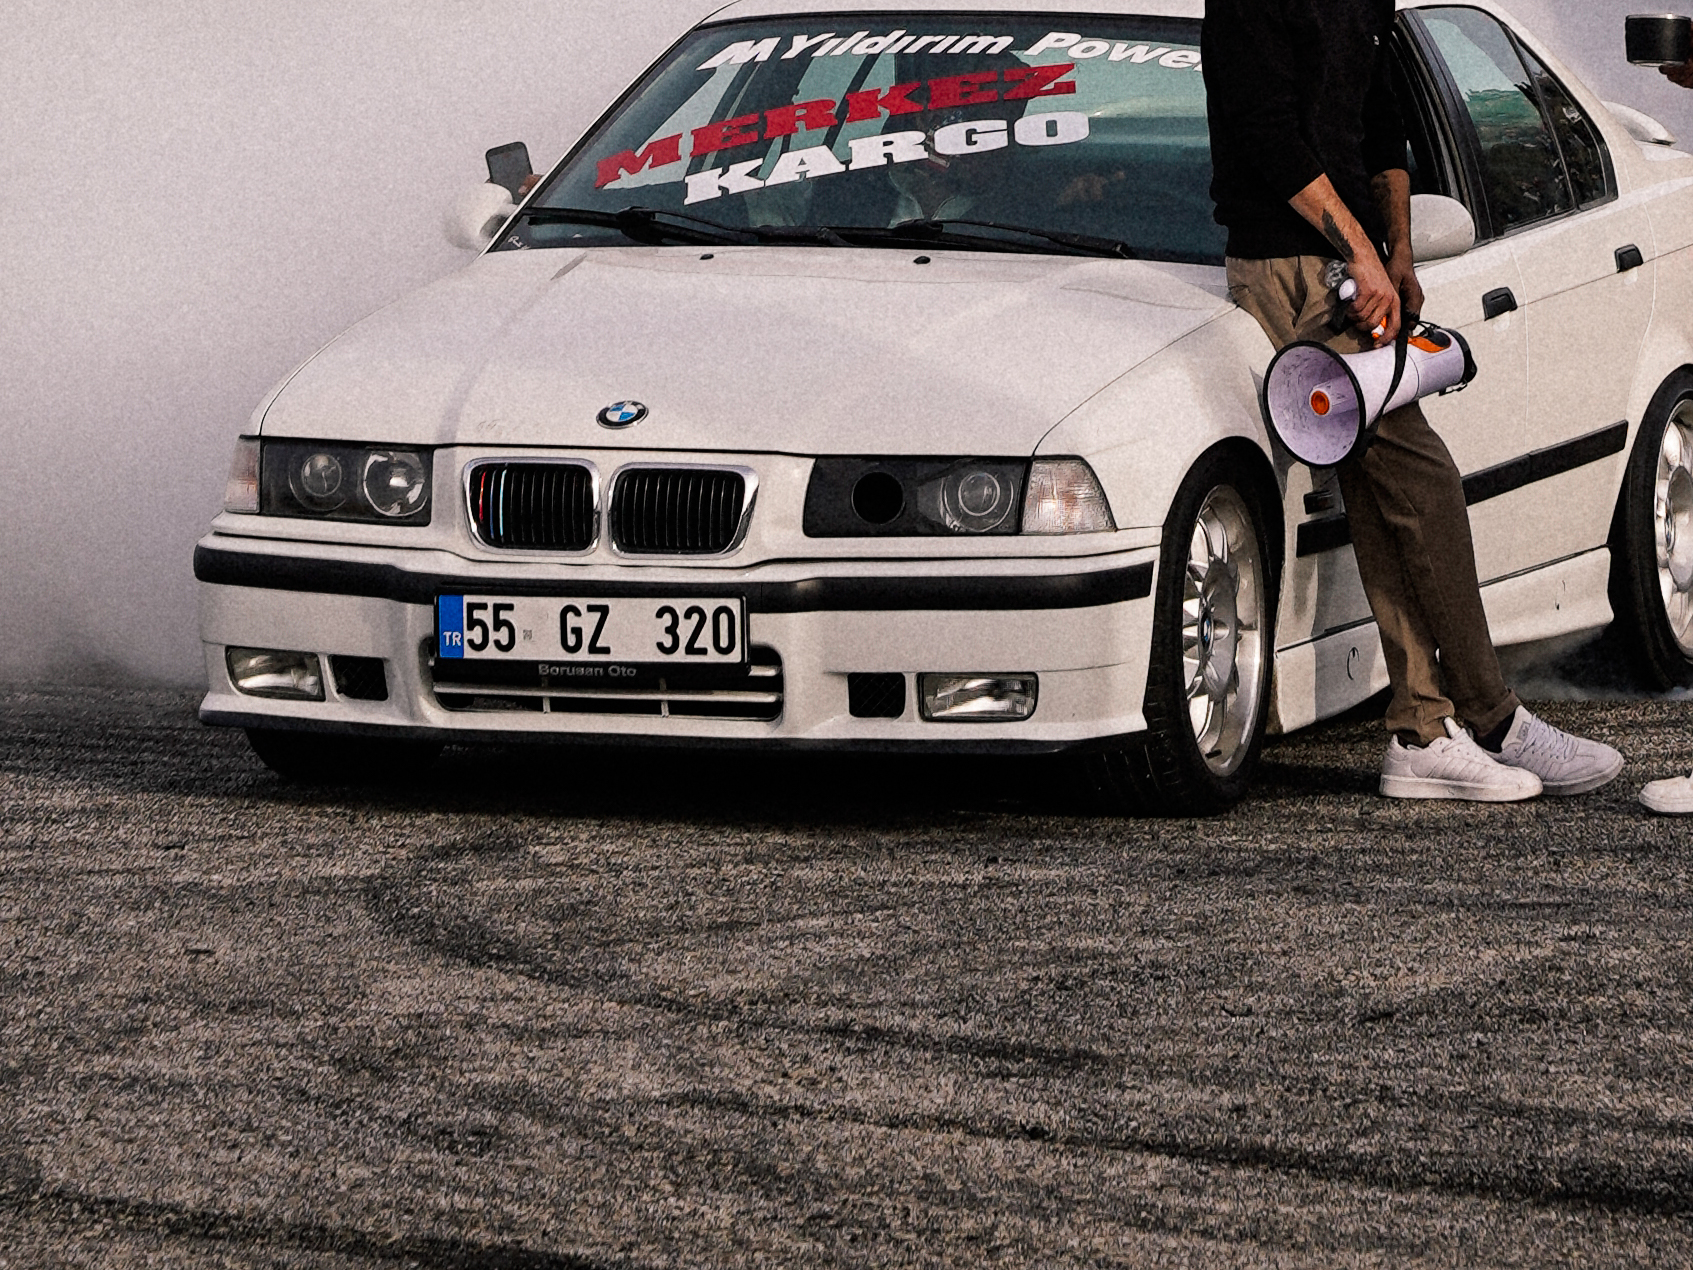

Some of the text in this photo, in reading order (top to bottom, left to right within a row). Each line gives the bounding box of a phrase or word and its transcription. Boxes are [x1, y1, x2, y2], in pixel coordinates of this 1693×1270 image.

[696, 37, 781, 71] M
[1024, 31, 1203, 72] Powe
[594, 62, 1077, 188] MERKEZ
[684, 112, 1090, 205] KARGO
[443, 602, 737, 656] TR 55 GZ 320
[538, 663, 637, 677] Borusan Oto
